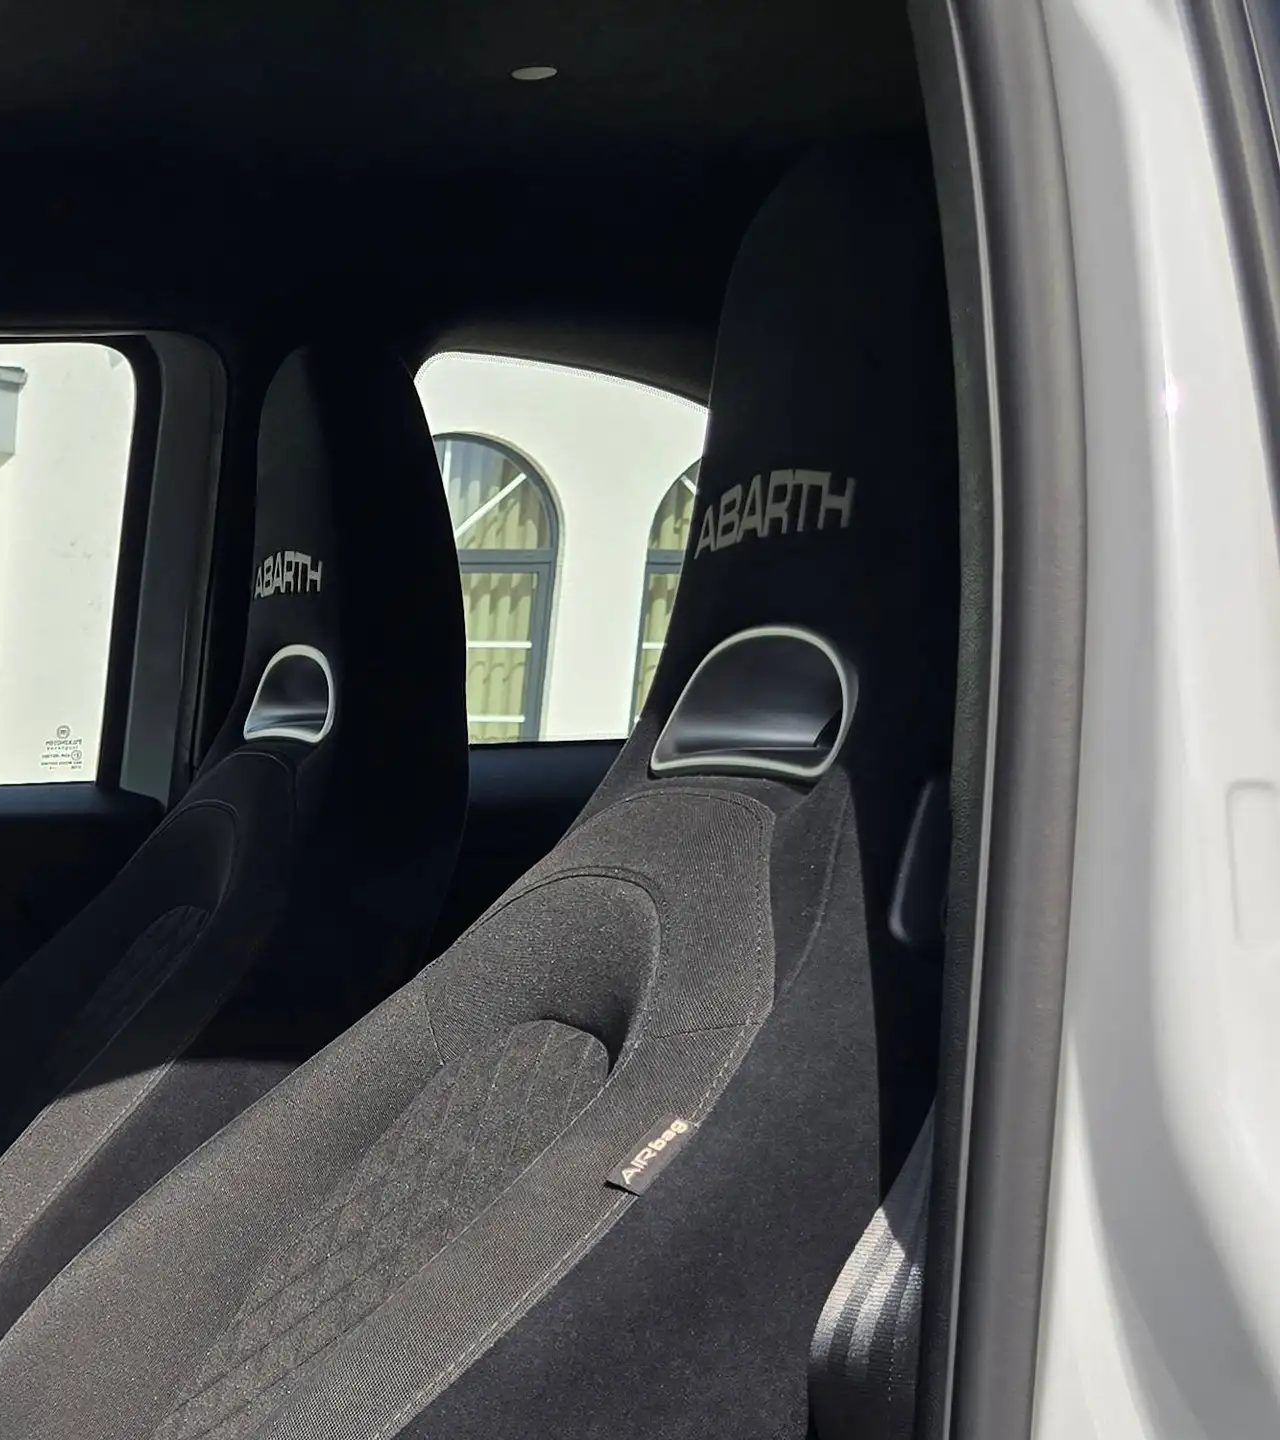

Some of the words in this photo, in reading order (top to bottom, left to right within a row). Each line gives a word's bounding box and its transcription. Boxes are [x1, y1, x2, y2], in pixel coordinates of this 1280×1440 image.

[694, 468, 856, 559] ABARTH
[254, 550, 323, 599] ABARTH
[622, 1119, 689, 1185] AIRbag
